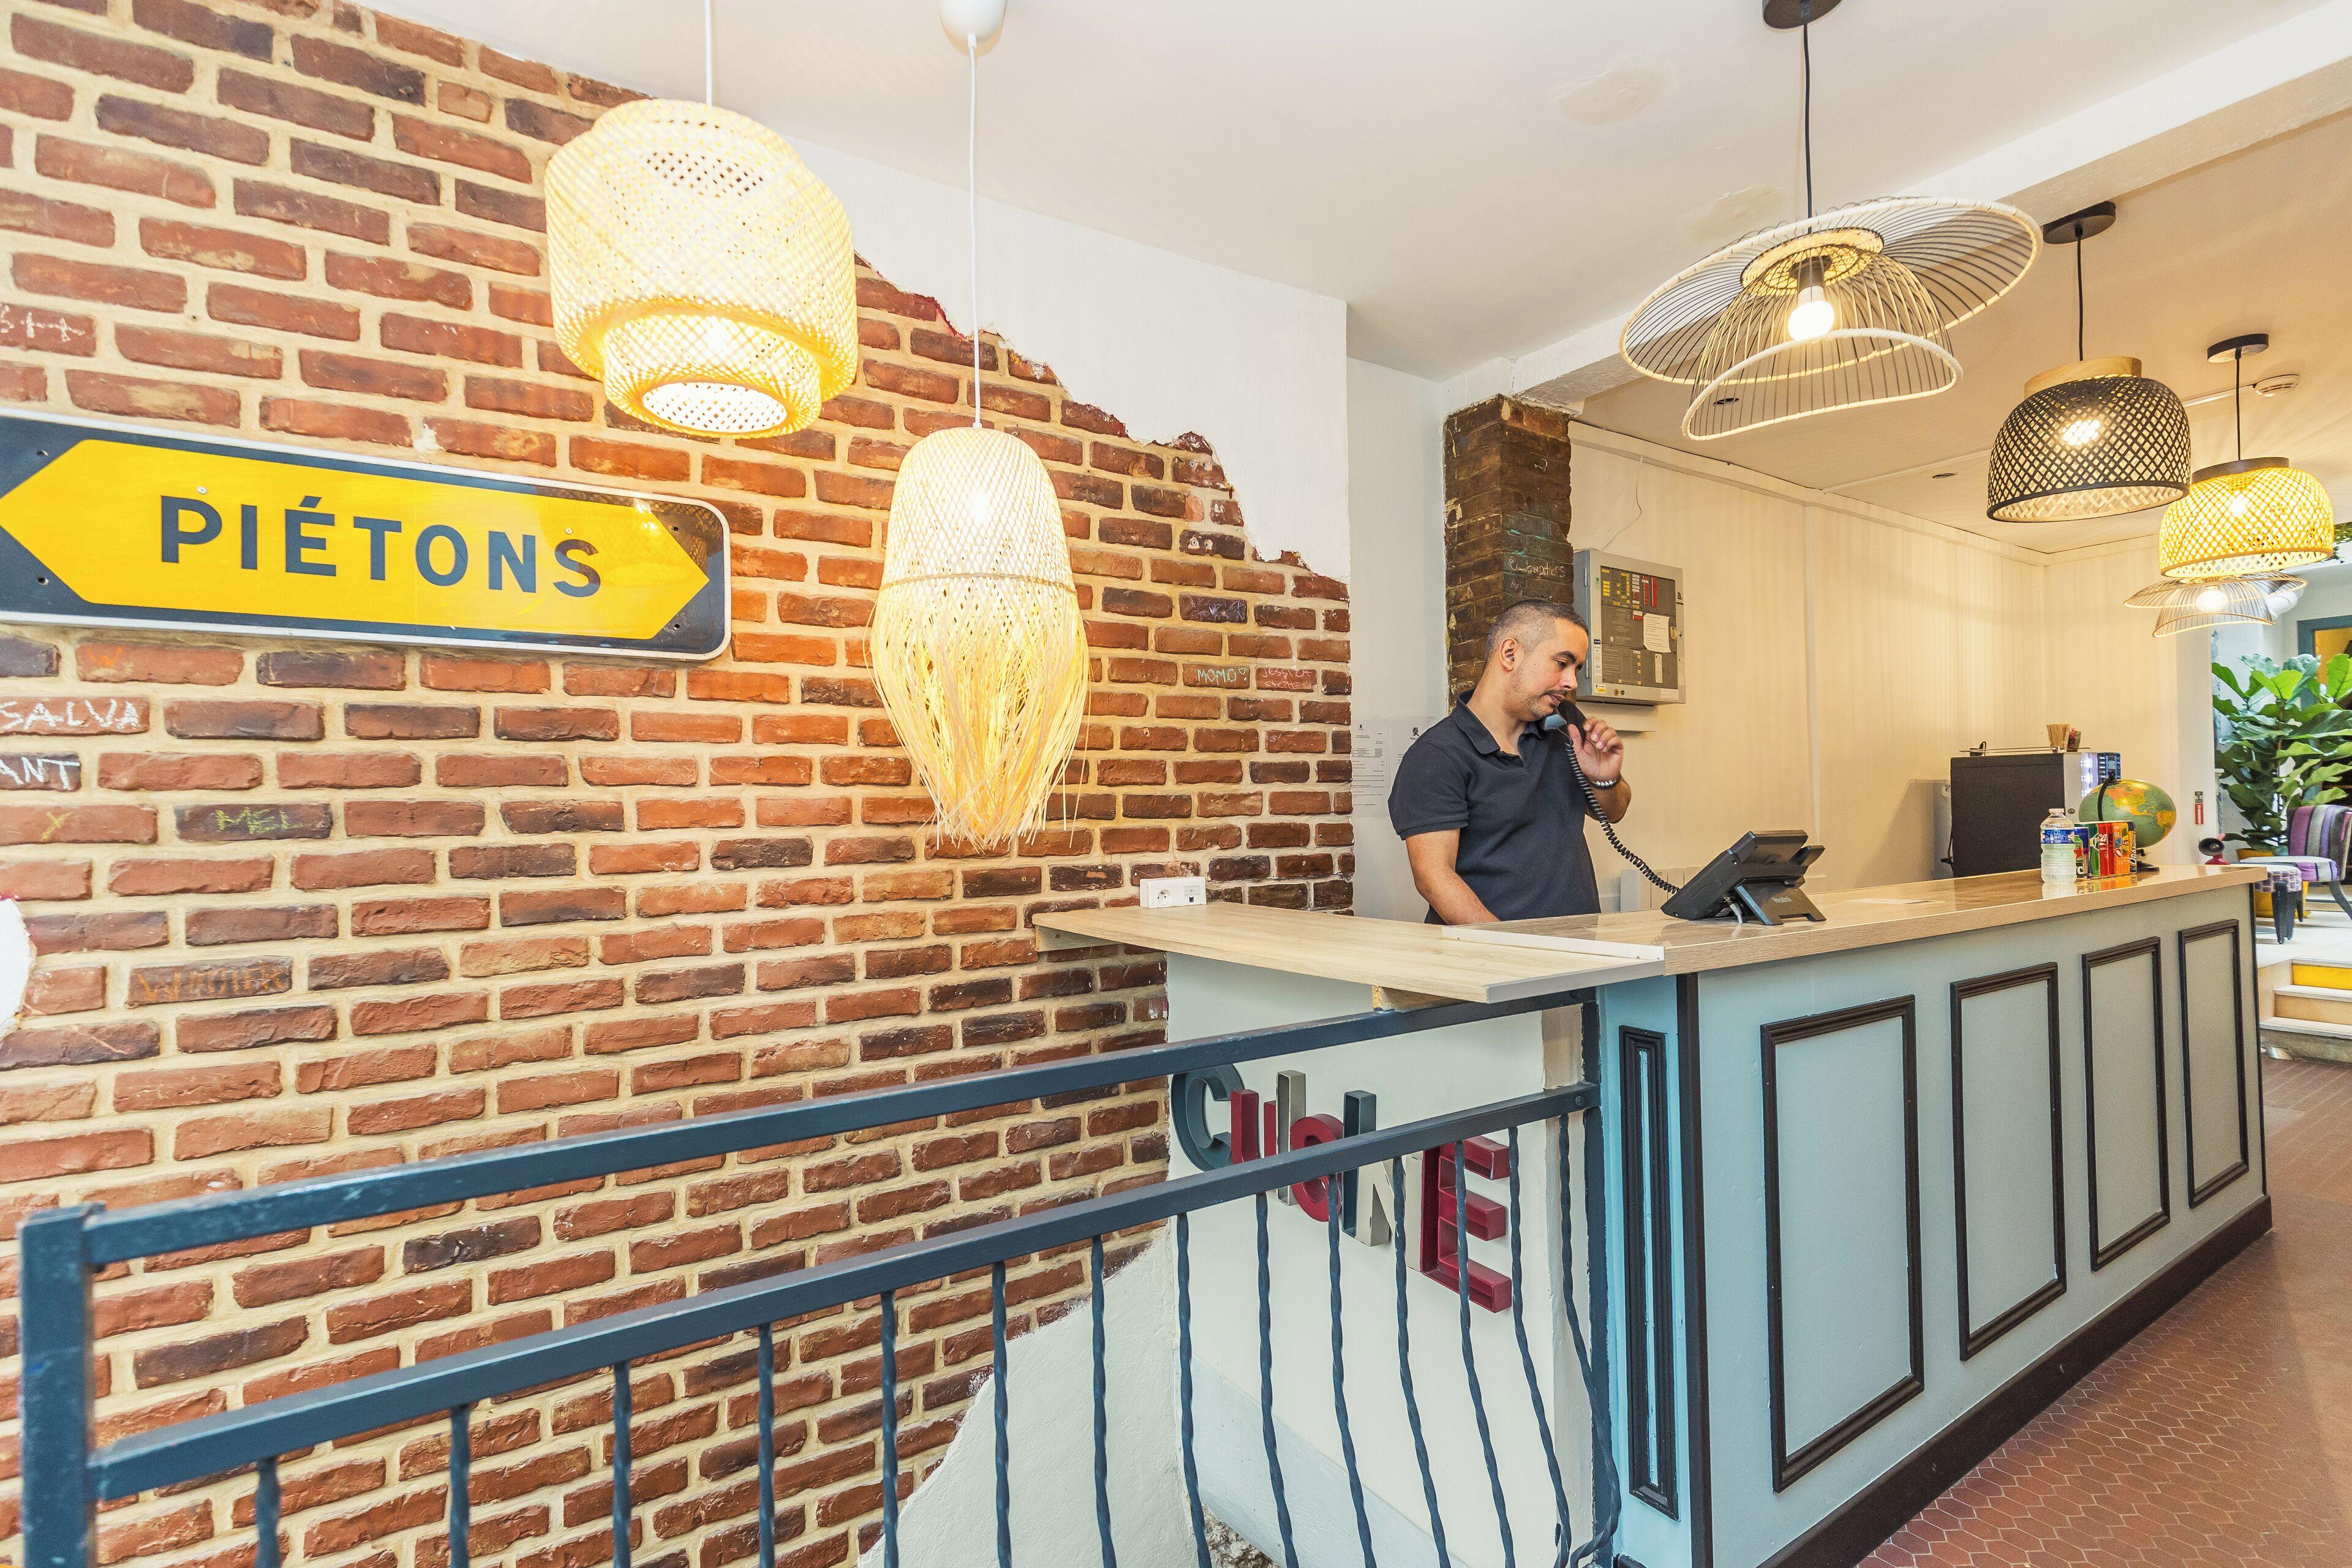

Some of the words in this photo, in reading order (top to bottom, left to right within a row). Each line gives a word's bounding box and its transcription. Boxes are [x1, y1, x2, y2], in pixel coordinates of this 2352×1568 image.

[160, 496, 601, 599] PIÉTONS
[0, 698, 141, 730] SALVA
[216, 806, 304, 835] MEL
